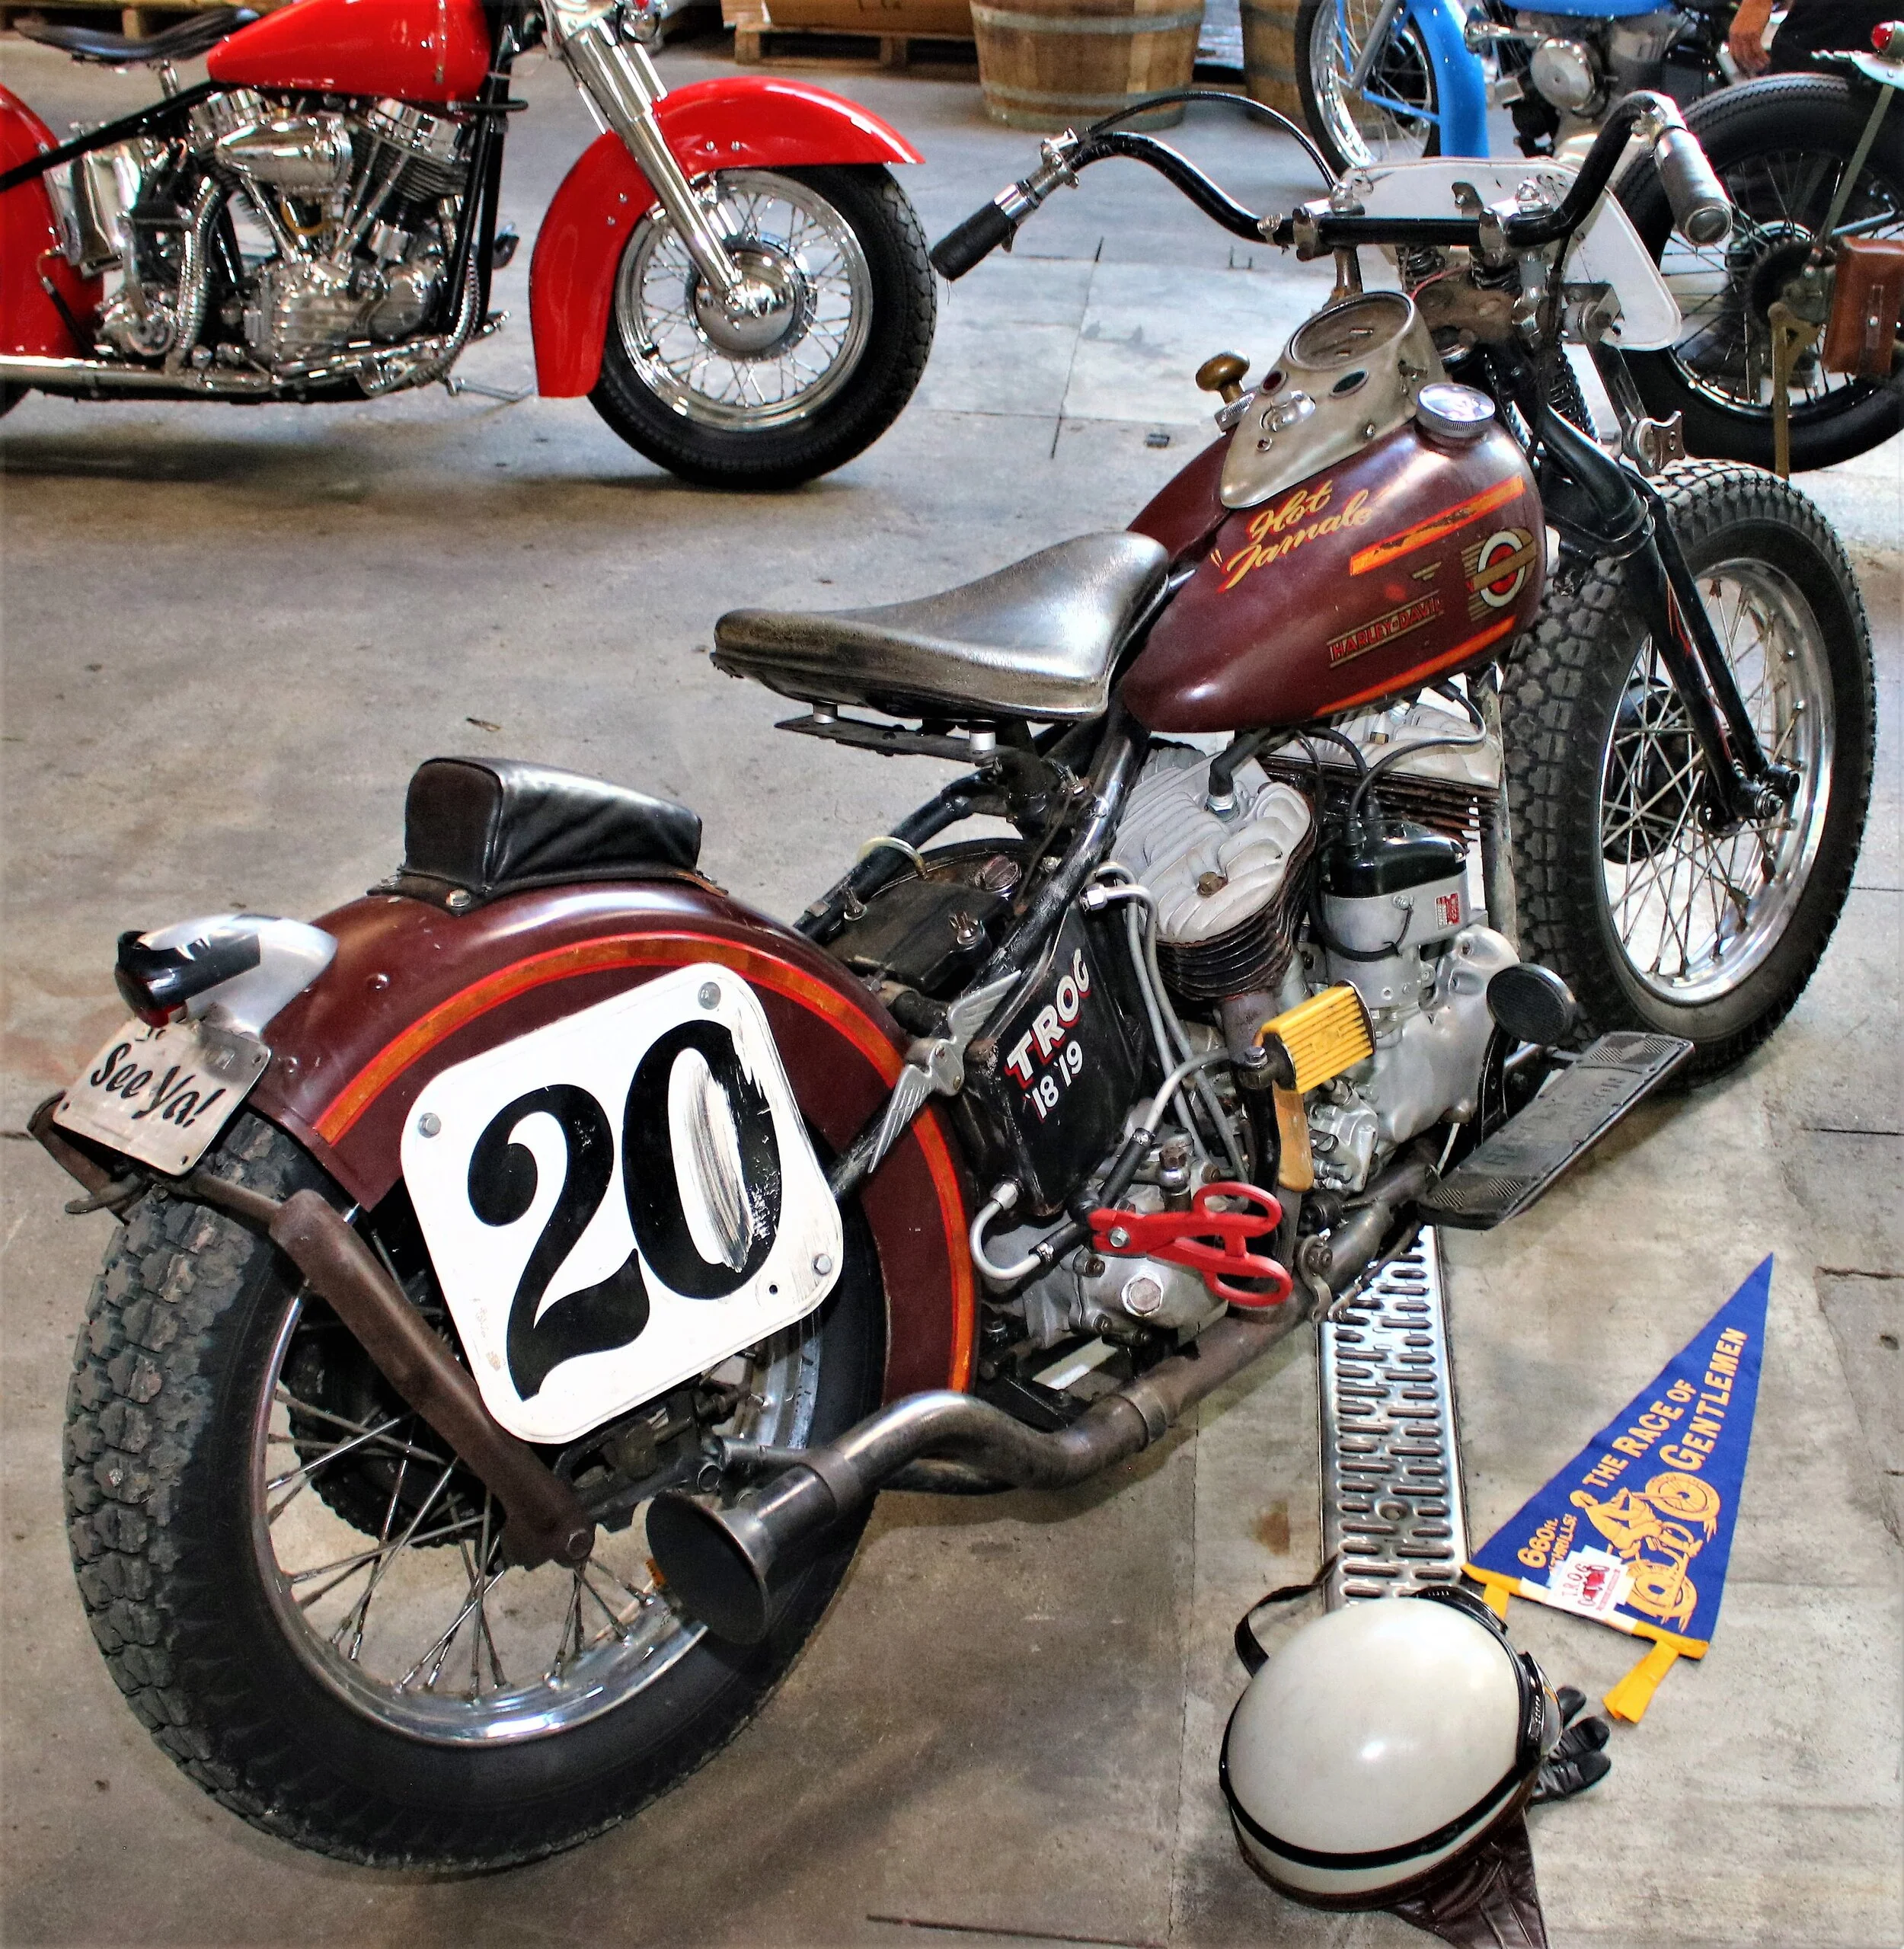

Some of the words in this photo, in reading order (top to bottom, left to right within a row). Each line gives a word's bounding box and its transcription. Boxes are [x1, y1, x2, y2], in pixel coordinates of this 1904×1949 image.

[1247, 480, 1333, 545] Hot
[1005, 948, 1090, 1085] TROG
[91, 1043, 153, 1098] See
[132, 1066, 226, 1128] Ya!
[468, 1019, 783, 1402] 20
[1582, 1453, 1630, 1488] THE
[1612, 1401, 1685, 1459] RACE
[1666, 1379, 1697, 1403] OF
[1659, 1327, 1748, 1471] GENTLEMEN
